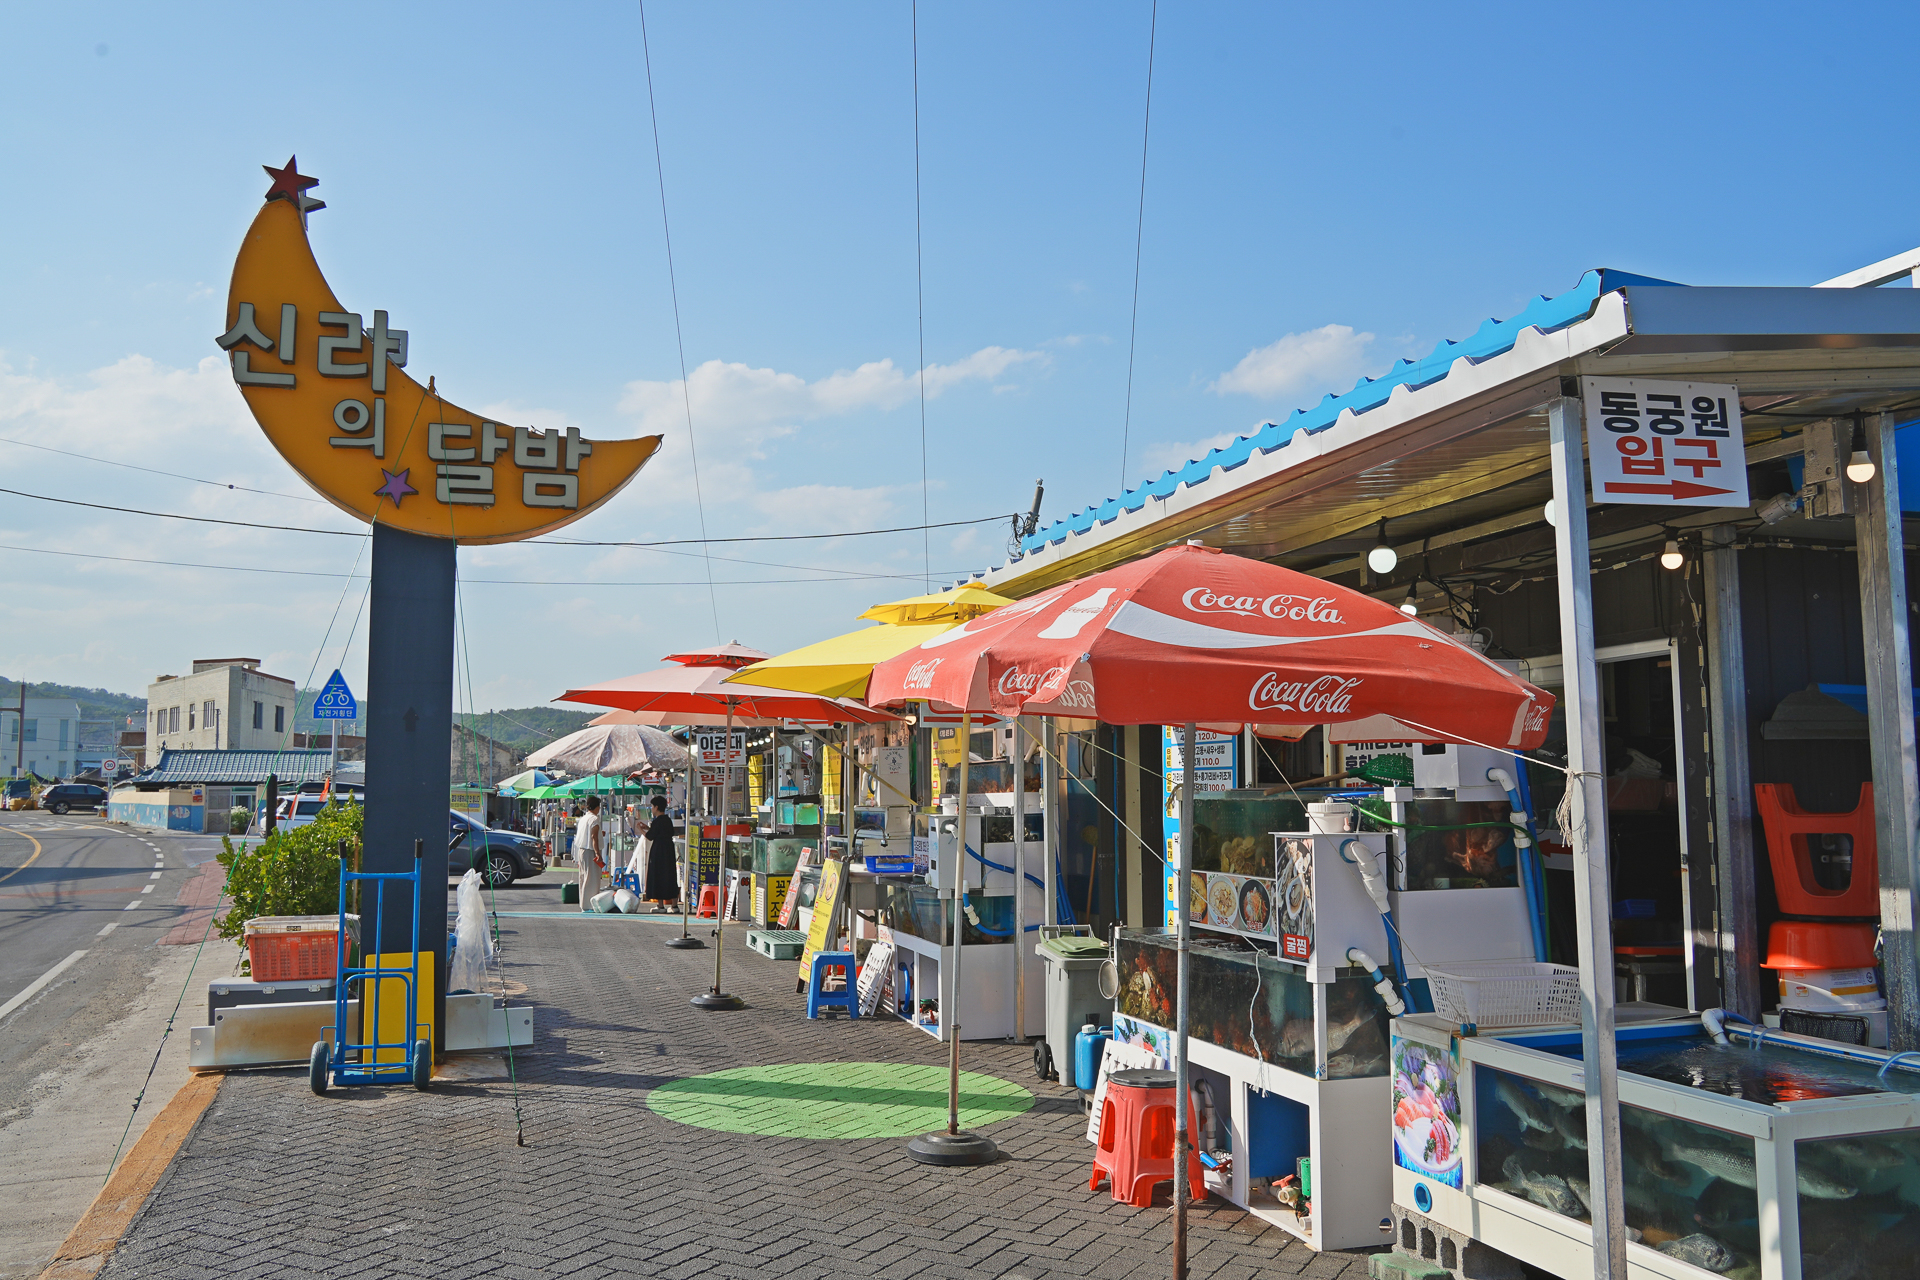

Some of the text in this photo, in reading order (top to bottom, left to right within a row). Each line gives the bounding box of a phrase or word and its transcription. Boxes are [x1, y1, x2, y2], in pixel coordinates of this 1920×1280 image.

[215, 302, 400, 395] 신라
[328, 397, 386, 460] 의
[1600, 391, 1730, 438] 동궁원
[427, 421, 593, 511] 달밤
[1615, 435, 1722, 479] 입구
[1182, 587, 1344, 624] Coca-Cola
[903, 657, 946, 690] Coca-Cola
[1248, 671, 1365, 714] Coca-Cola
[318, 709, 353, 718] 자전거횡단
[700, 735, 742, 751] 이견대
[702, 750, 741, 760] 입구
[1168, 841, 1173, 859] 특대
[1168, 883, 1173, 892] 중
[1168, 917, 1173, 926] 소
[1286, 936, 1307, 956] 굴찜
